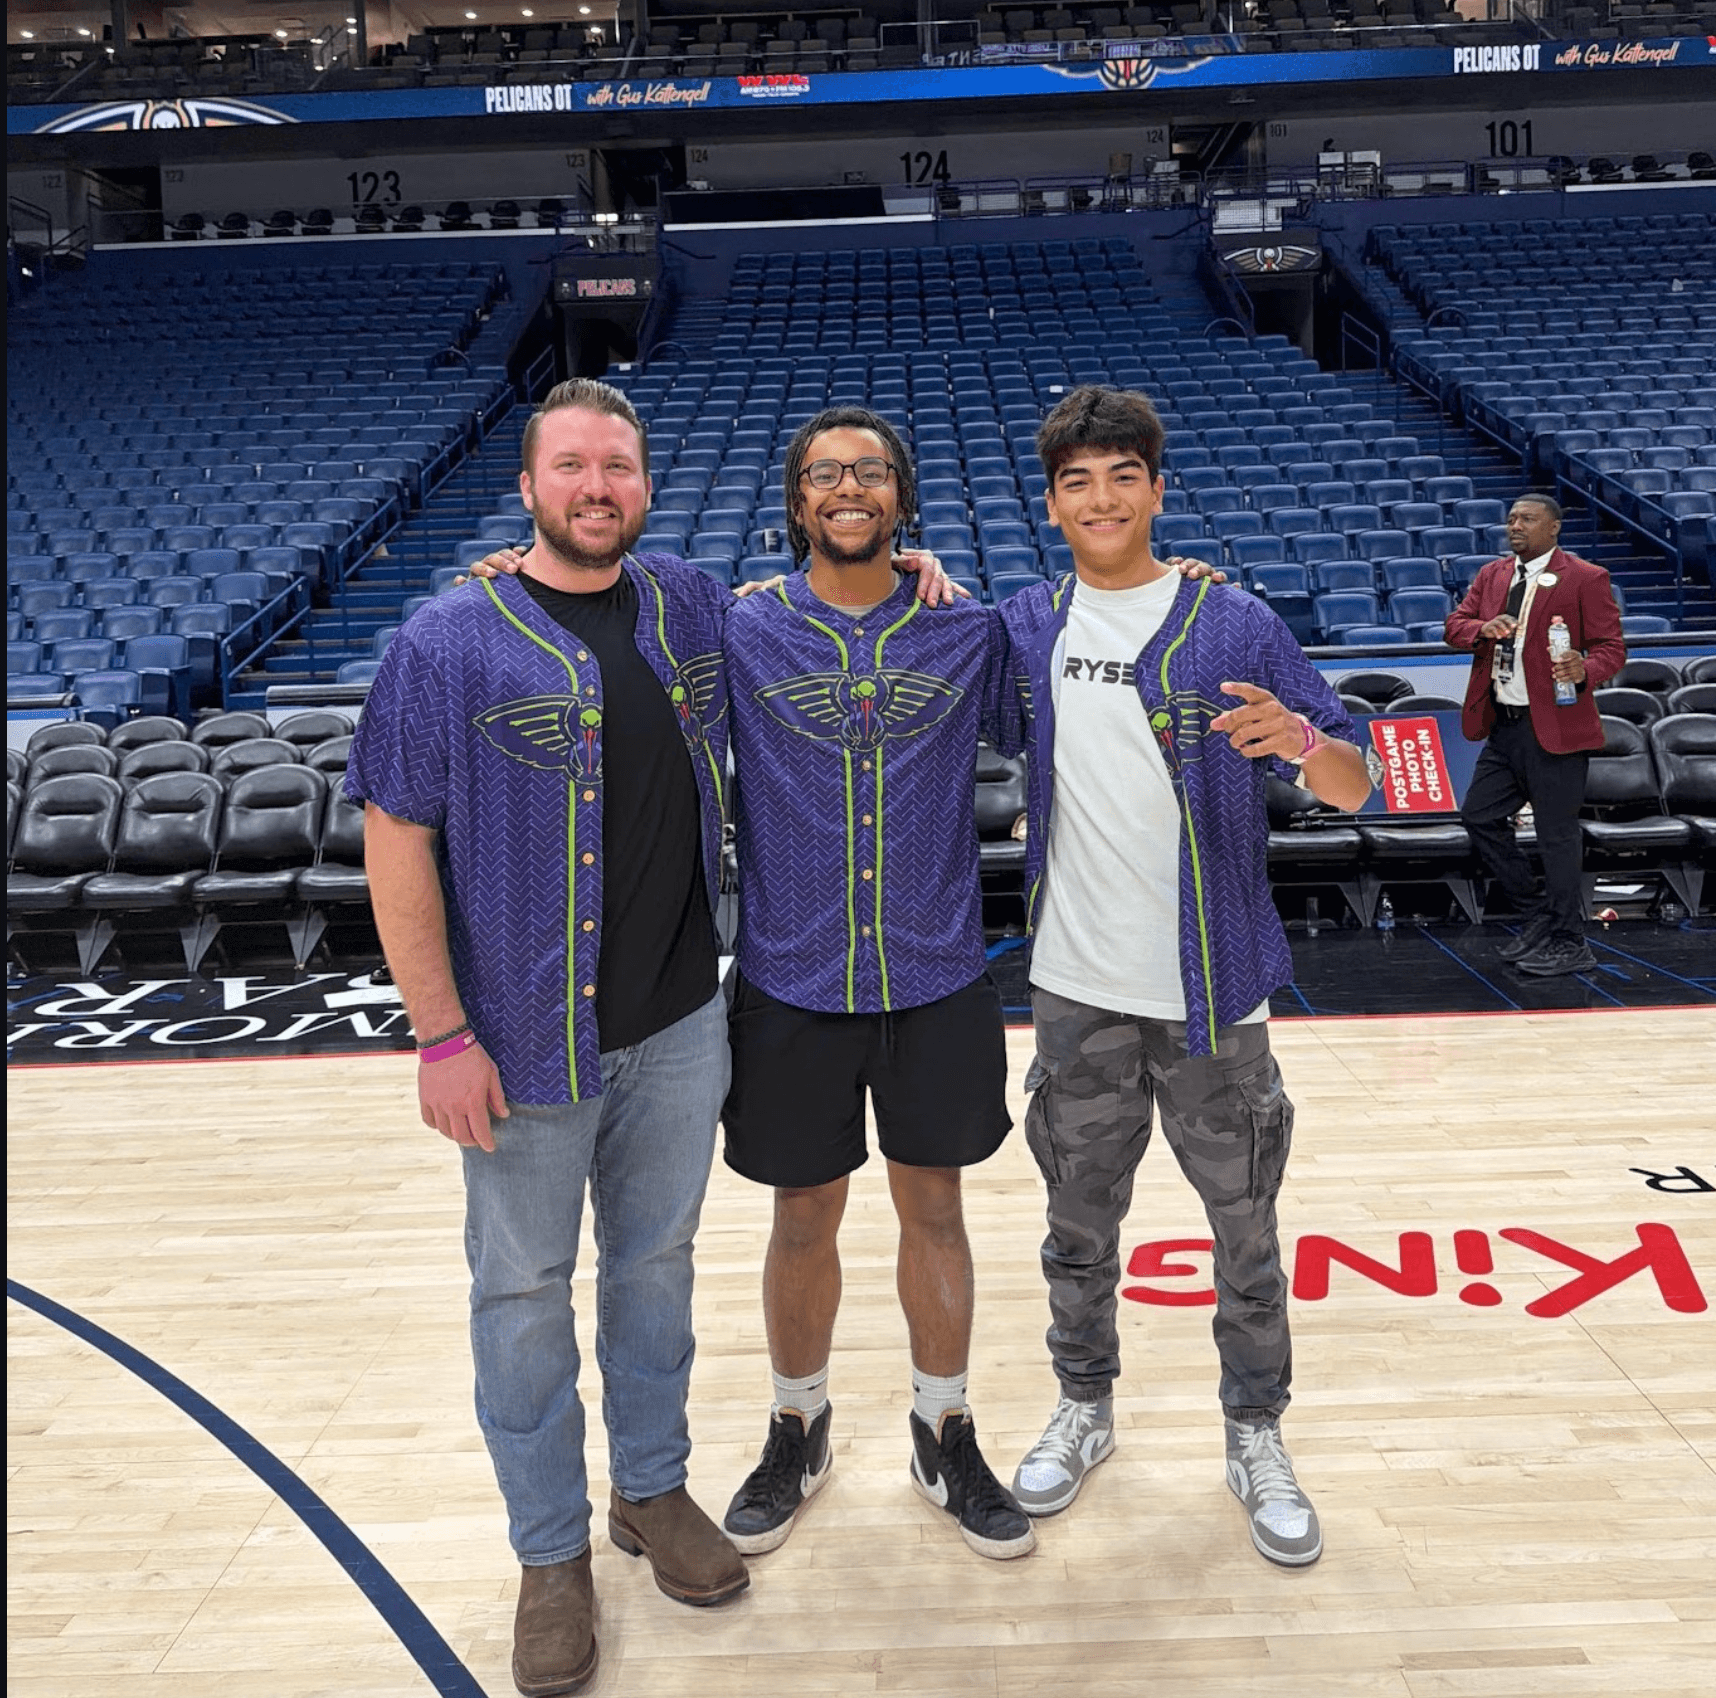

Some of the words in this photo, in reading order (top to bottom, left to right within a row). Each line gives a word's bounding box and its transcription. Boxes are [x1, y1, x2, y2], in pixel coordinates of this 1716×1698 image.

[1453, 45, 1521, 73] PELICANS
[1522, 44, 1541, 71] OT
[1555, 44, 1582, 67] with
[1584, 43, 1611, 68] Gus
[485, 85, 553, 113] PELICANS
[554, 83, 572, 111] OT
[586, 84, 614, 107] with
[616, 83, 643, 108] Gus
[1146, 128, 1165, 144] 124
[1269, 123, 1288, 138] 101
[1484, 119, 1533, 157] 101
[565, 153, 586, 168] 123
[690, 148, 709, 164] 124
[900, 150, 952, 189] 124
[347, 170, 402, 208] 123
[577, 278, 637, 297] PELICANS
[1063, 656, 1137, 687] RYSE
[1381, 724, 1411, 809] POSTGAME
[1401, 739, 1424, 793] PHOTO
[1416, 728, 1443, 803] CHECK-IN
